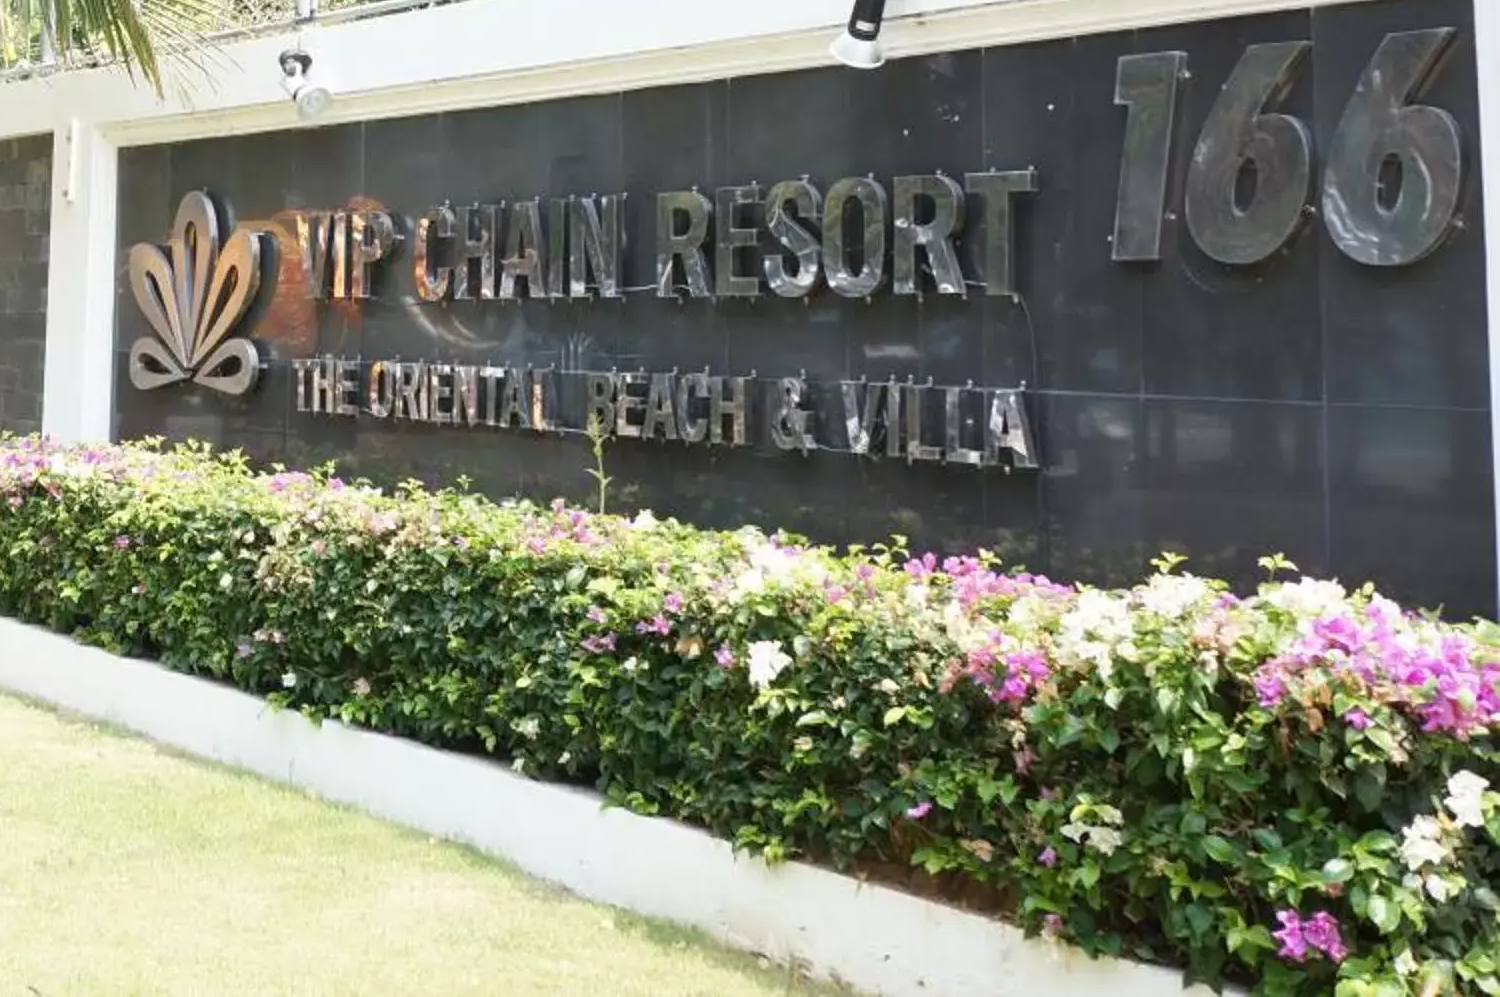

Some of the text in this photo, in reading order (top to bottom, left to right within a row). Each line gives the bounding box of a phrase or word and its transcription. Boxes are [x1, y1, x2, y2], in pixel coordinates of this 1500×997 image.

[1111, 26, 1464, 266] 166
[296, 171, 1038, 301] VIP CHAIN RESORT
[293, 358, 1039, 469] THE ORIENTAL BEACH & VILLA
